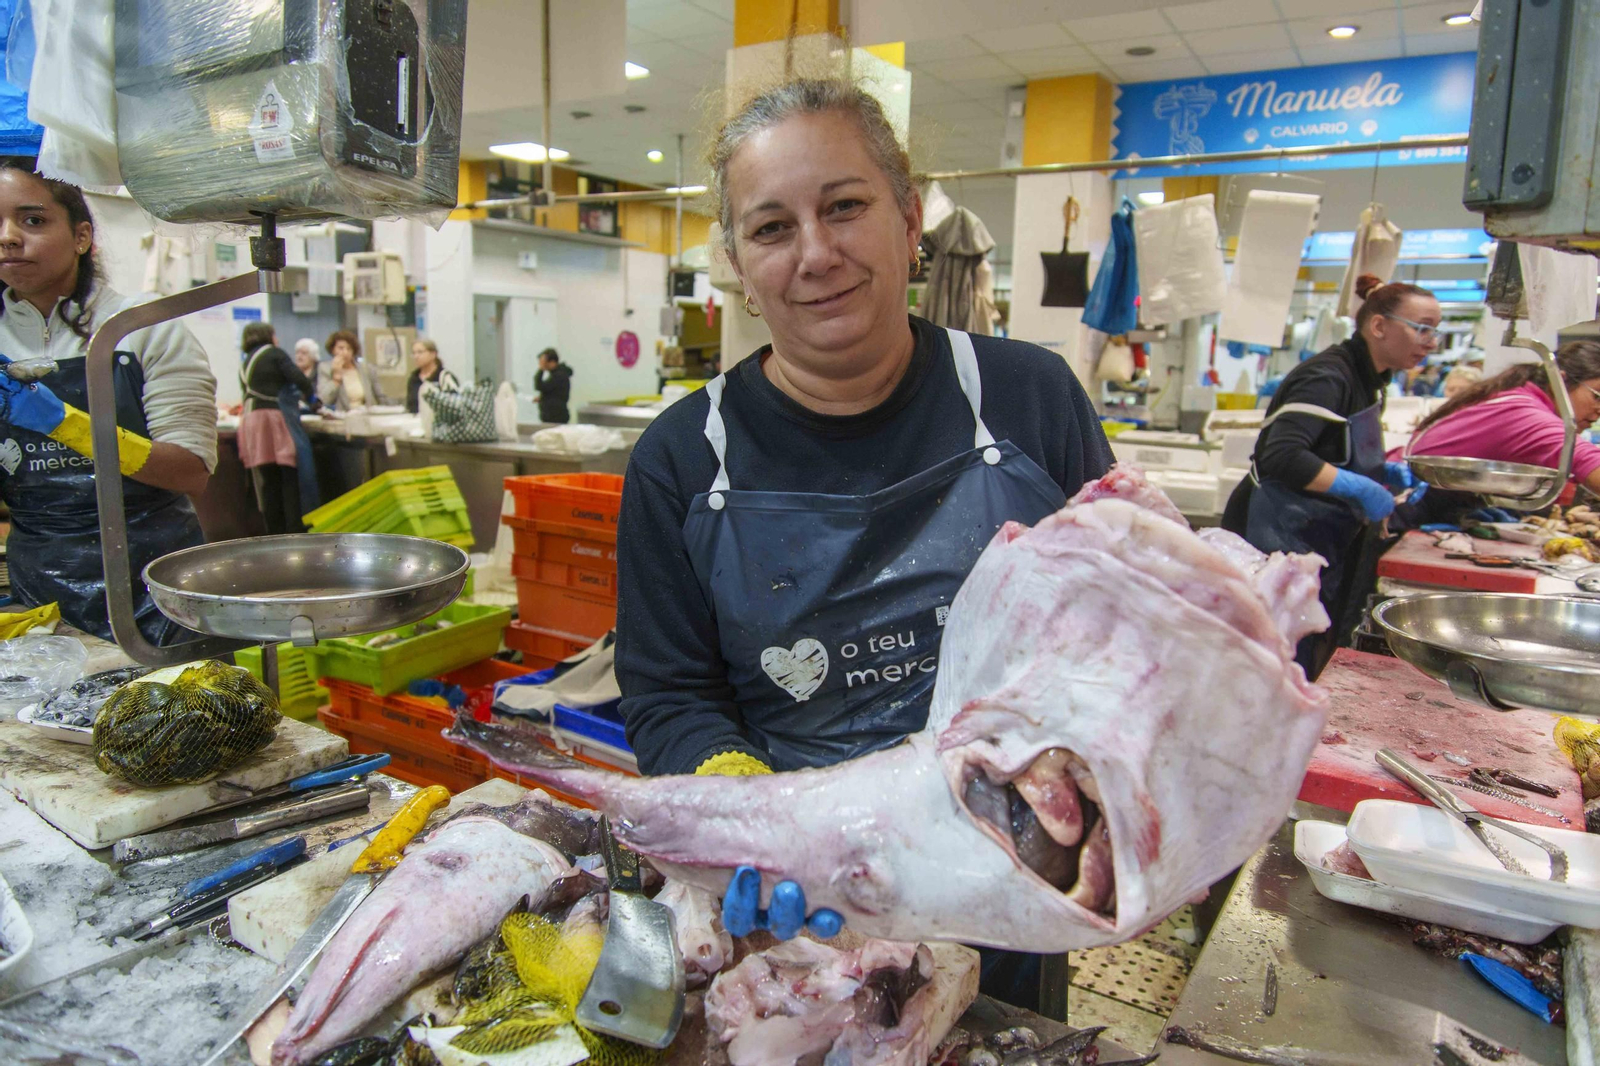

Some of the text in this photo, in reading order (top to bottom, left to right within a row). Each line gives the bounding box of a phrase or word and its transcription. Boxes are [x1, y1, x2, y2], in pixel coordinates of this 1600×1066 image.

[1227, 71, 1403, 118] Manuela
[1271, 121, 1348, 138] CALVARIO
[353, 153, 398, 170] EPELSA
[26, 441, 67, 453] o teu
[30, 456, 93, 471] merca
[841, 631, 915, 658] o teu
[846, 657, 936, 687] merc
